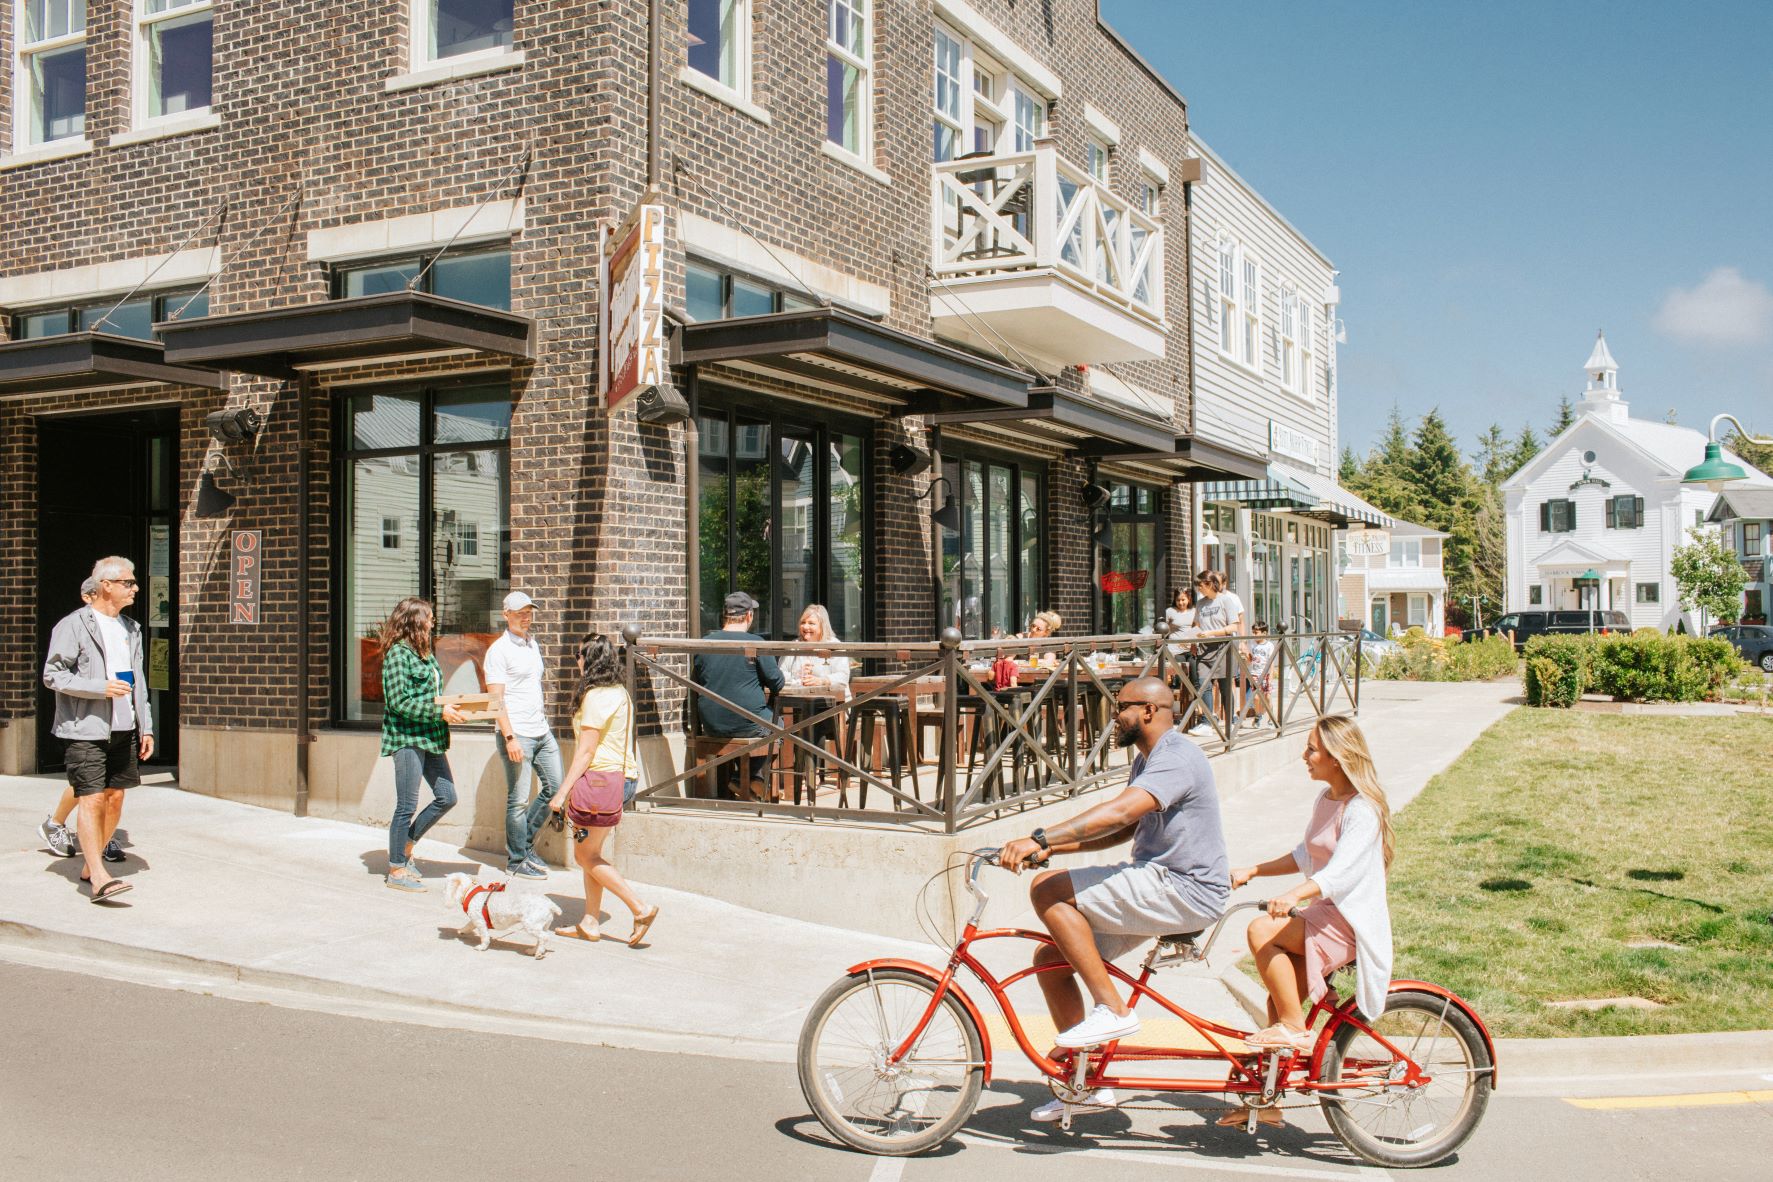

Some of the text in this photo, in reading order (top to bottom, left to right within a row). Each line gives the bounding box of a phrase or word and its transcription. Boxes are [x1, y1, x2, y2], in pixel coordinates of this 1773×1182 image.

[641, 208, 662, 384] PIZZA
[233, 532, 257, 622] OPEN
[1354, 541, 1384, 554] FITNESS
